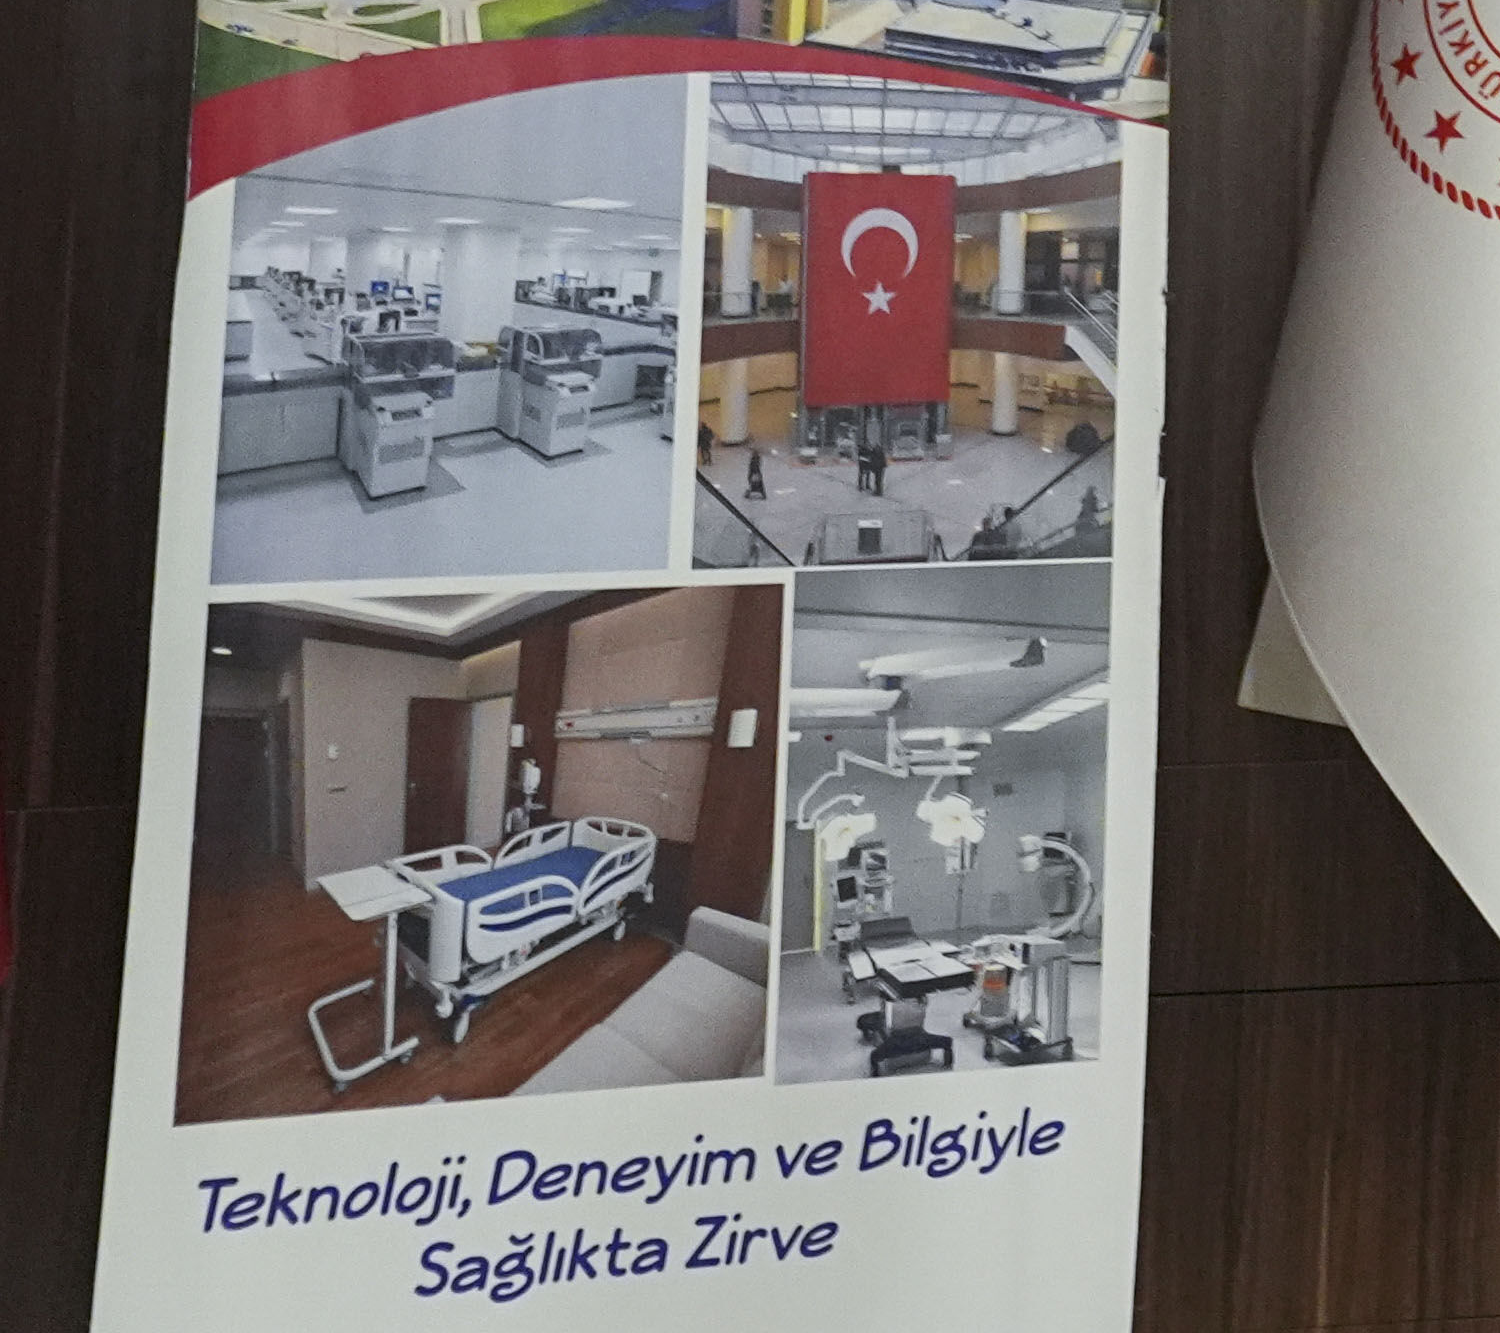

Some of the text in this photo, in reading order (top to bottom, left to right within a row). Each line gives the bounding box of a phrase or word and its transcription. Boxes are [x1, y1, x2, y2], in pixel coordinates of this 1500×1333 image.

[197, 1105, 1067, 1234] Teknoloji, Deneyim ve Bilgiyle
[414, 1208, 840, 1304] Sağlıkta Zirve
